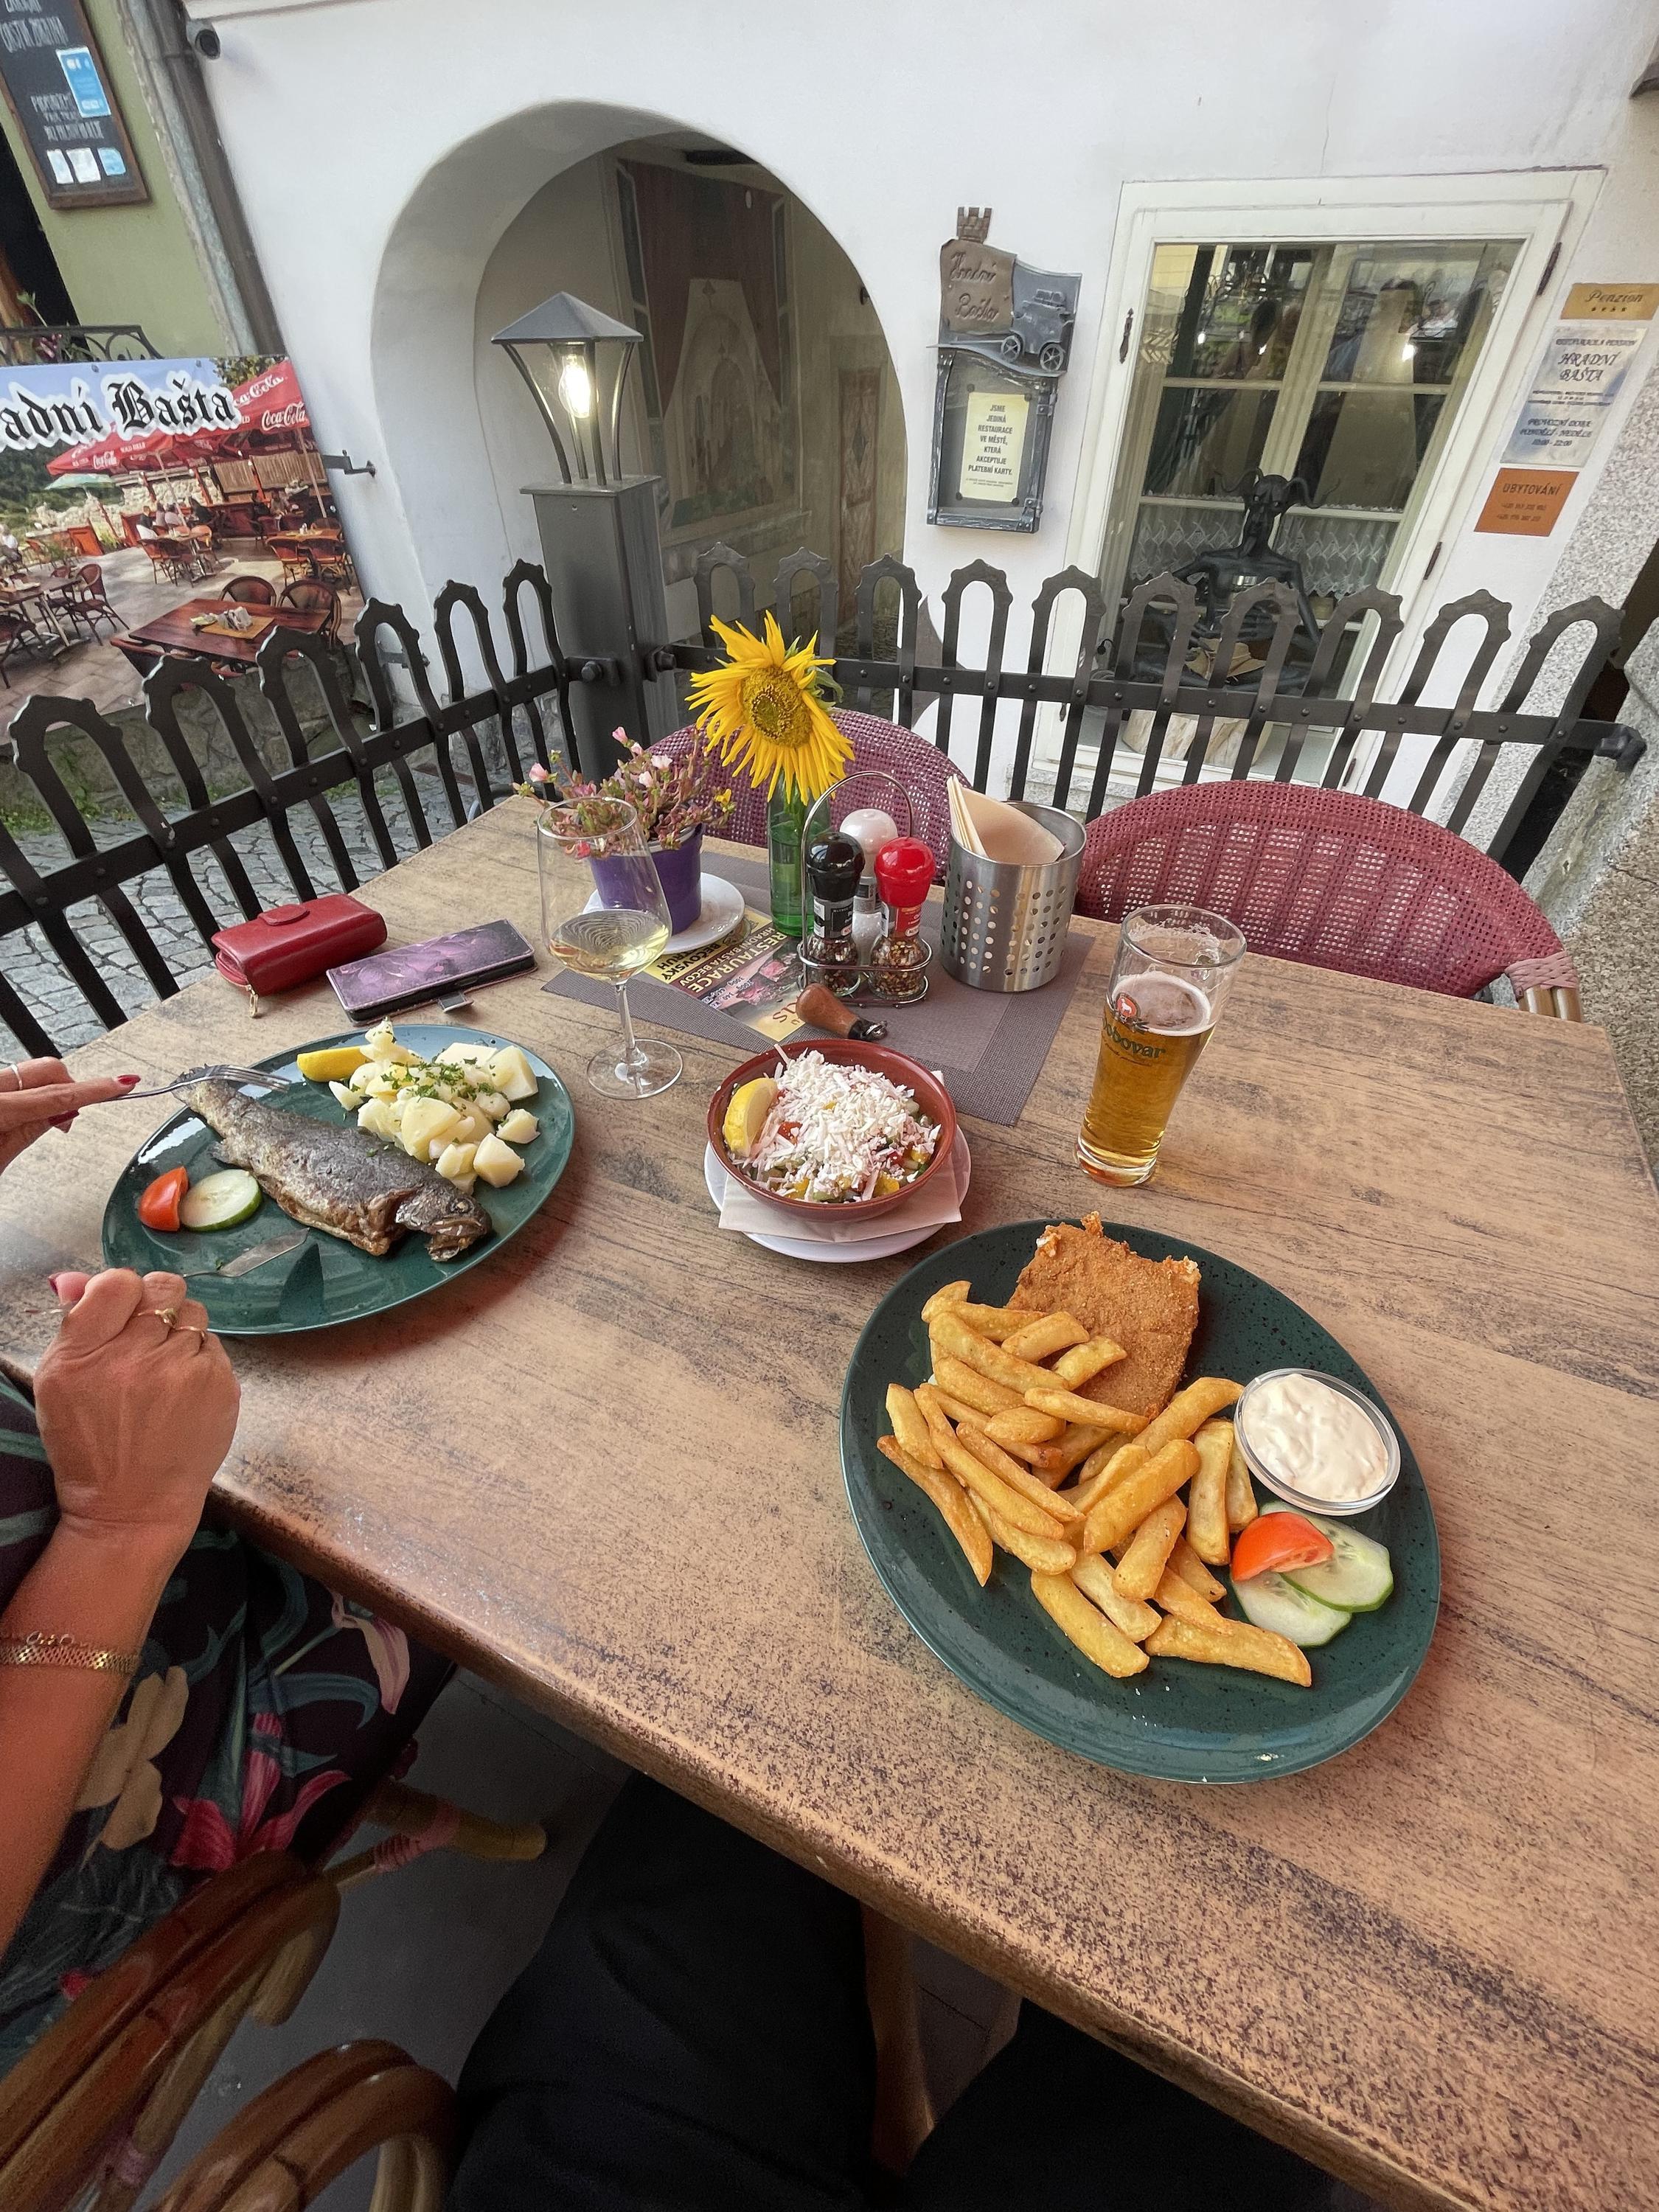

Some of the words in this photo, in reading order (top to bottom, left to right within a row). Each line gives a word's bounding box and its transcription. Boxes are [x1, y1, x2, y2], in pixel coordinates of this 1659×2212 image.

[1557, 352, 1621, 366] HRADNÍ
[1559, 367, 1604, 381] BAŠTA
[108, 378, 236, 432] Bašta
[987, 414, 1006, 423] JEDINÁ
[978, 425, 1013, 434] RESTAURACE
[984, 445, 1001, 454] KTERÁ
[976, 456, 1007, 465] AKCEPTUJE
[968, 465, 993, 473] PLATEBNÍ
[994, 467, 1012, 476] KARTY.
[1503, 483, 1562, 495] UBYTOVÁNÍ
[661, 943, 721, 981] BEČOVSKÝ
[687, 932, 787, 992] RESTAURACE
[679, 964, 712, 987] BEČOV
